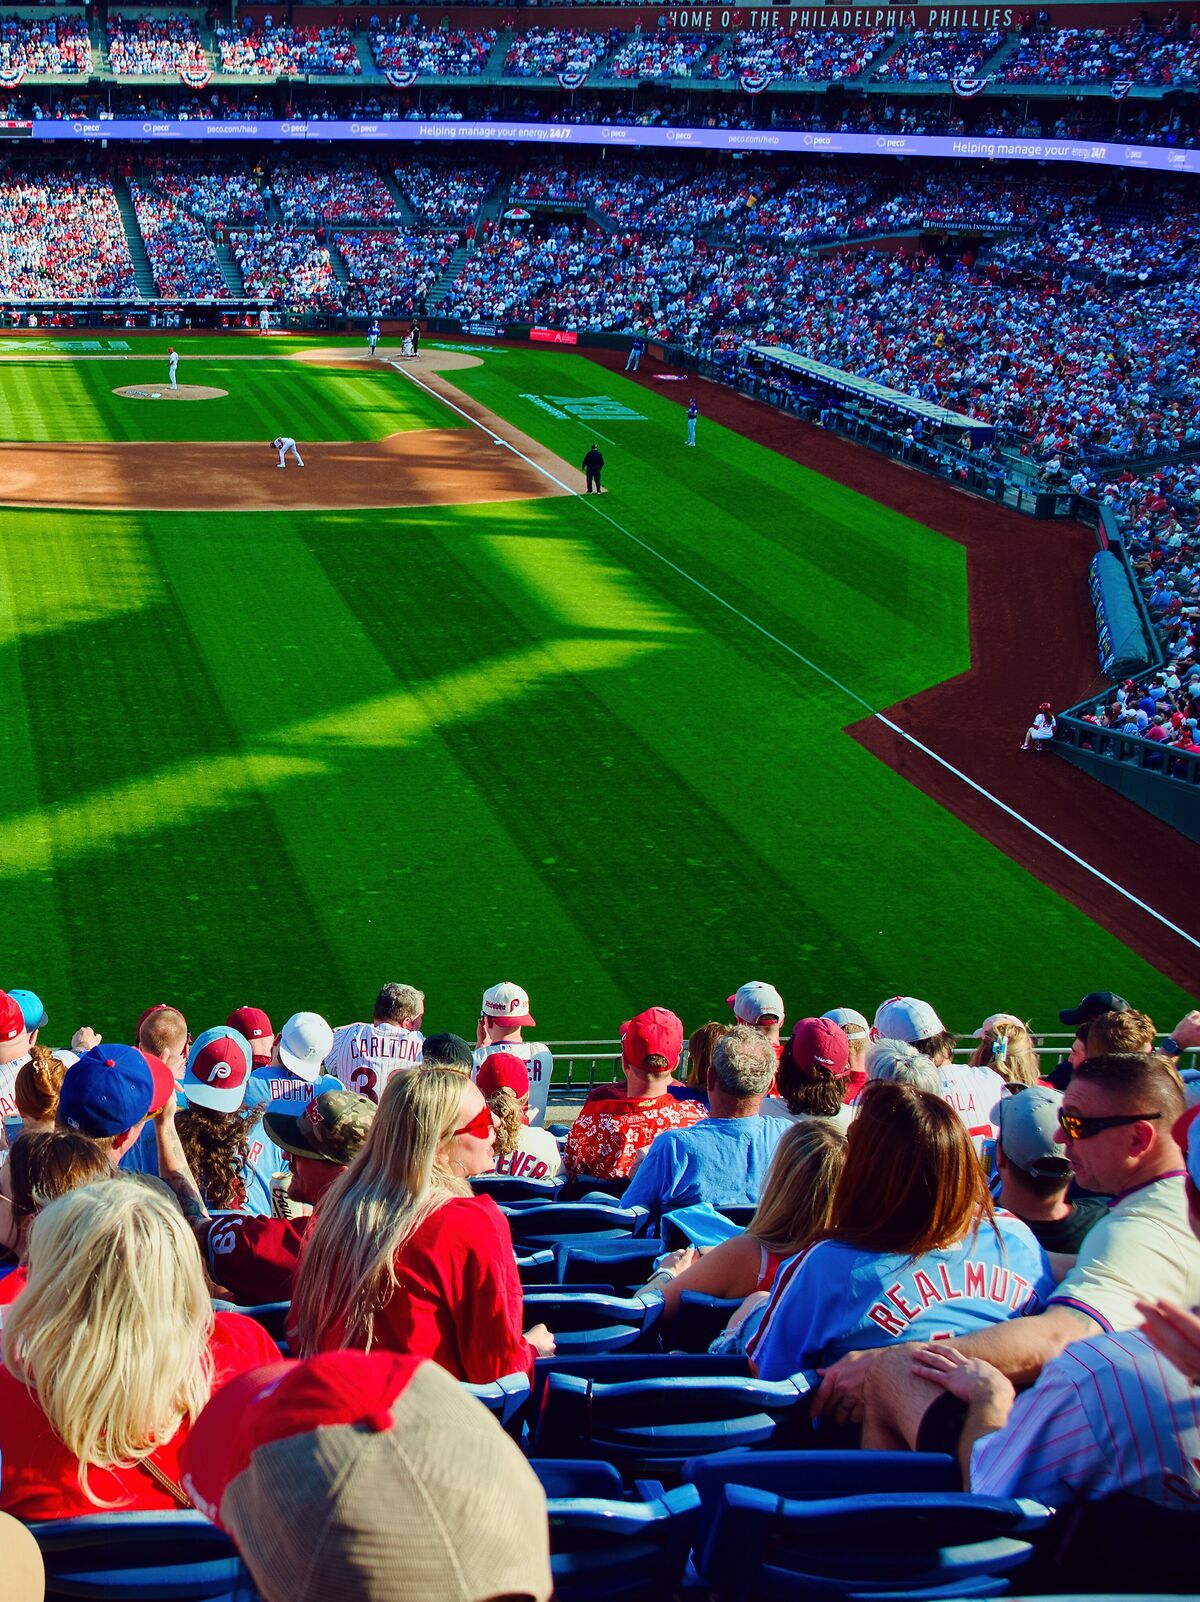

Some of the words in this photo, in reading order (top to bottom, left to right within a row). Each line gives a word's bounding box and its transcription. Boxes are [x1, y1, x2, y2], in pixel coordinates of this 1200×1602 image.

[750, 11, 779, 27] THE
[790, 10, 916, 27] PHILADELPHIA
[929, 9, 1013, 27] PHILLIES
[83, 124, 100, 132] peco
[207, 124, 258, 134] peco.com/help
[360, 125, 377, 133] peco
[419, 126, 456, 137] Helping
[458, 128, 496, 138] manage
[496, 128, 517, 138] your
[610, 130, 626, 138] peco
[675, 131, 692, 140] peco
[728, 135, 779, 145] peco.com/help
[813, 136, 831, 145] peco
[887, 138, 905, 147] peco
[953, 141, 995, 156] Helping
[998, 144, 1042, 156] manage
[1044, 145, 1069, 157] your
[930, 221, 972, 229] PHILADELPHIA
[973, 223, 1006, 231] INSURANCE
[350, 1036, 420, 1063] CARLTON
[207, 1061, 232, 1082] P
[270, 1079, 315, 1101] BOHM
[866, 1259, 1041, 1338] REALMUTO
